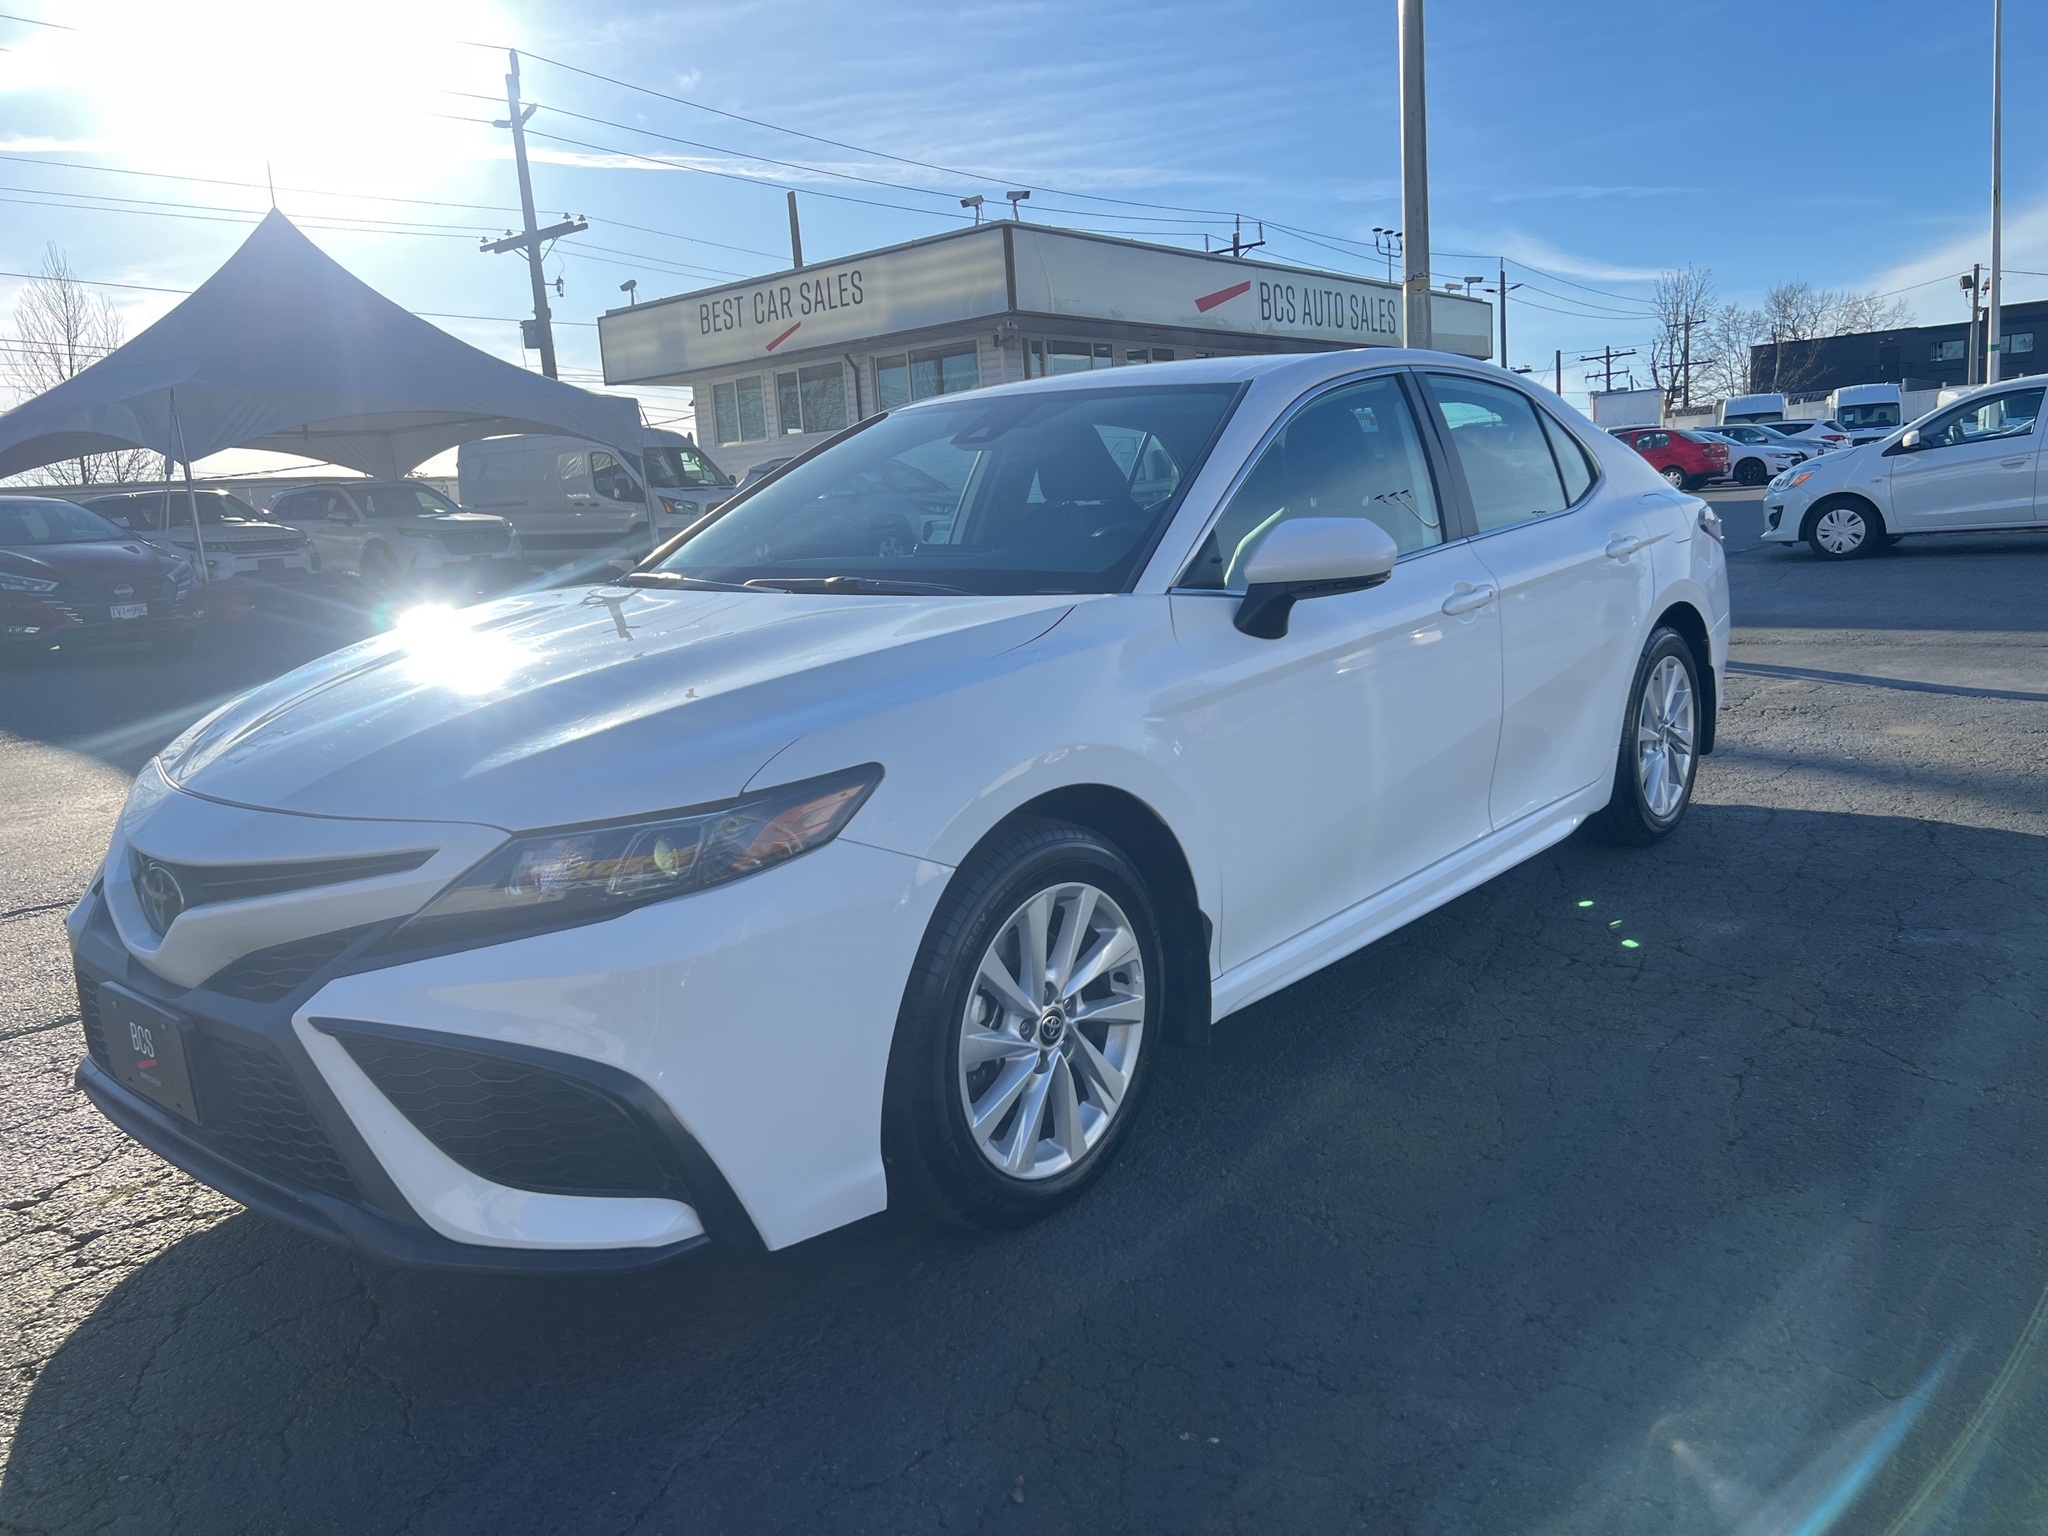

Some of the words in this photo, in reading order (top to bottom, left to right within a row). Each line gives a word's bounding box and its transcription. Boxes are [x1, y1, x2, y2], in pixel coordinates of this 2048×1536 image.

[700, 296, 744, 335] BEST
[753, 286, 793, 324] CAR
[800, 270, 864, 315] SALES
[1259, 281, 1296, 324] BCS
[1302, 287, 1344, 329] AUTO
[1350, 294, 1396, 334] SALES
[130, 1021, 155, 1058] BCS
